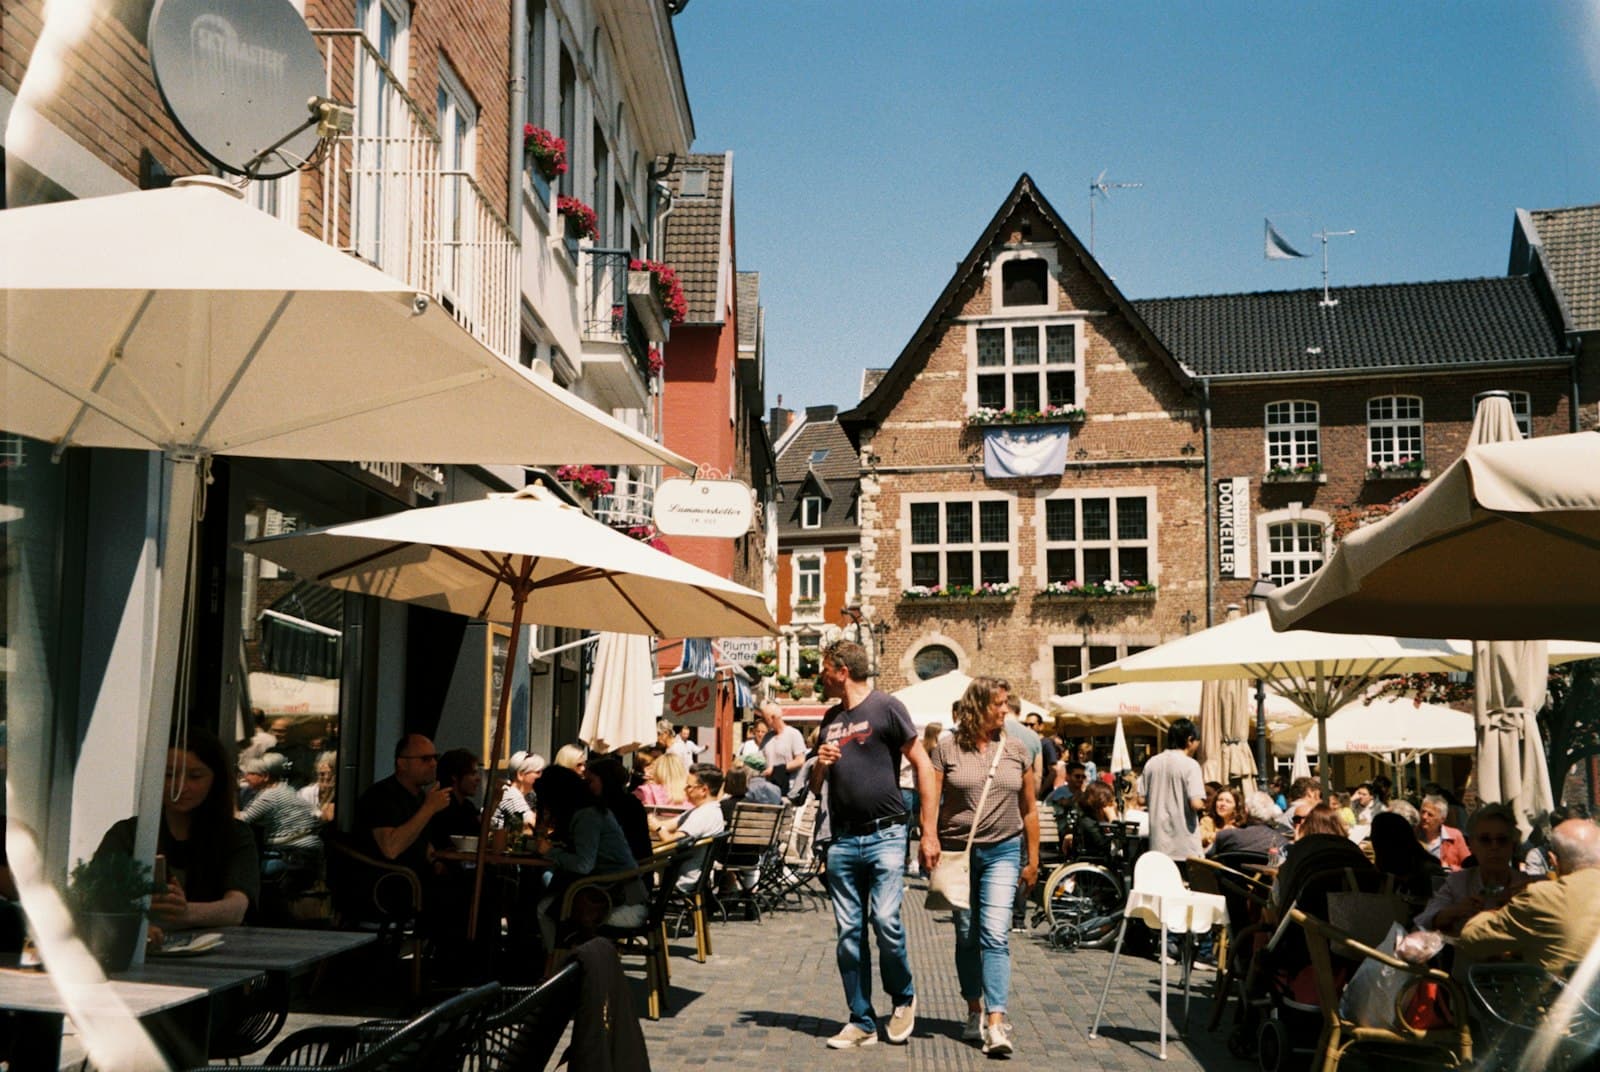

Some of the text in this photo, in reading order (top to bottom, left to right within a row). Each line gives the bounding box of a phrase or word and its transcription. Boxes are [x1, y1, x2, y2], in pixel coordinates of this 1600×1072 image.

[1218, 483, 1234, 572] DOMKELLER
[723, 640, 758, 651] Plum's
[670, 679, 710, 714] Eis
